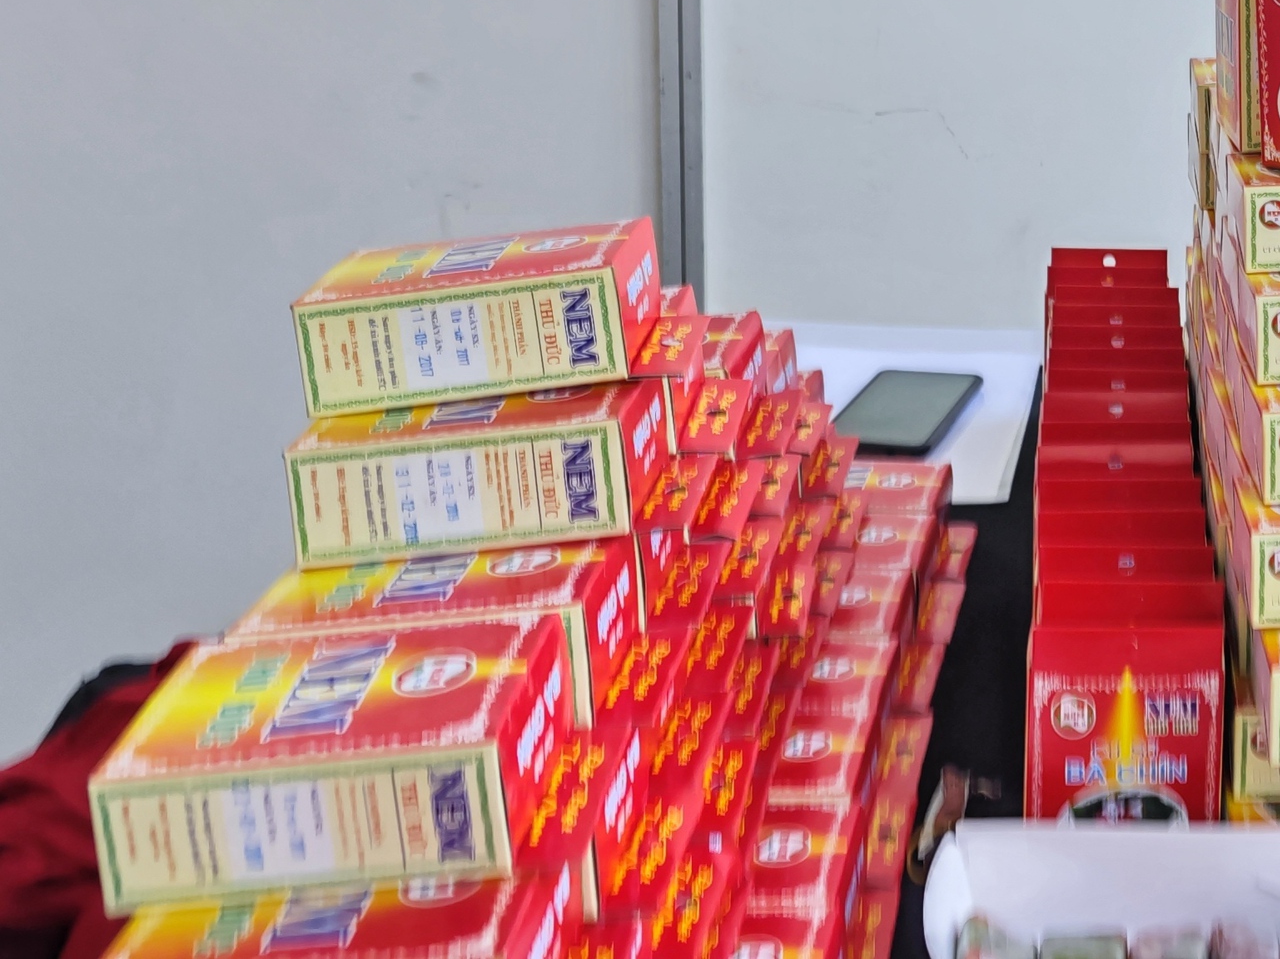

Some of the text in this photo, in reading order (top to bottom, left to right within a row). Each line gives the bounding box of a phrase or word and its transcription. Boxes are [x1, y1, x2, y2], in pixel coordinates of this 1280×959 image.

[538, 298, 563, 366] THỦ ĐỨC
[560, 287, 600, 368] NEM
[561, 441, 599, 524] NEM
